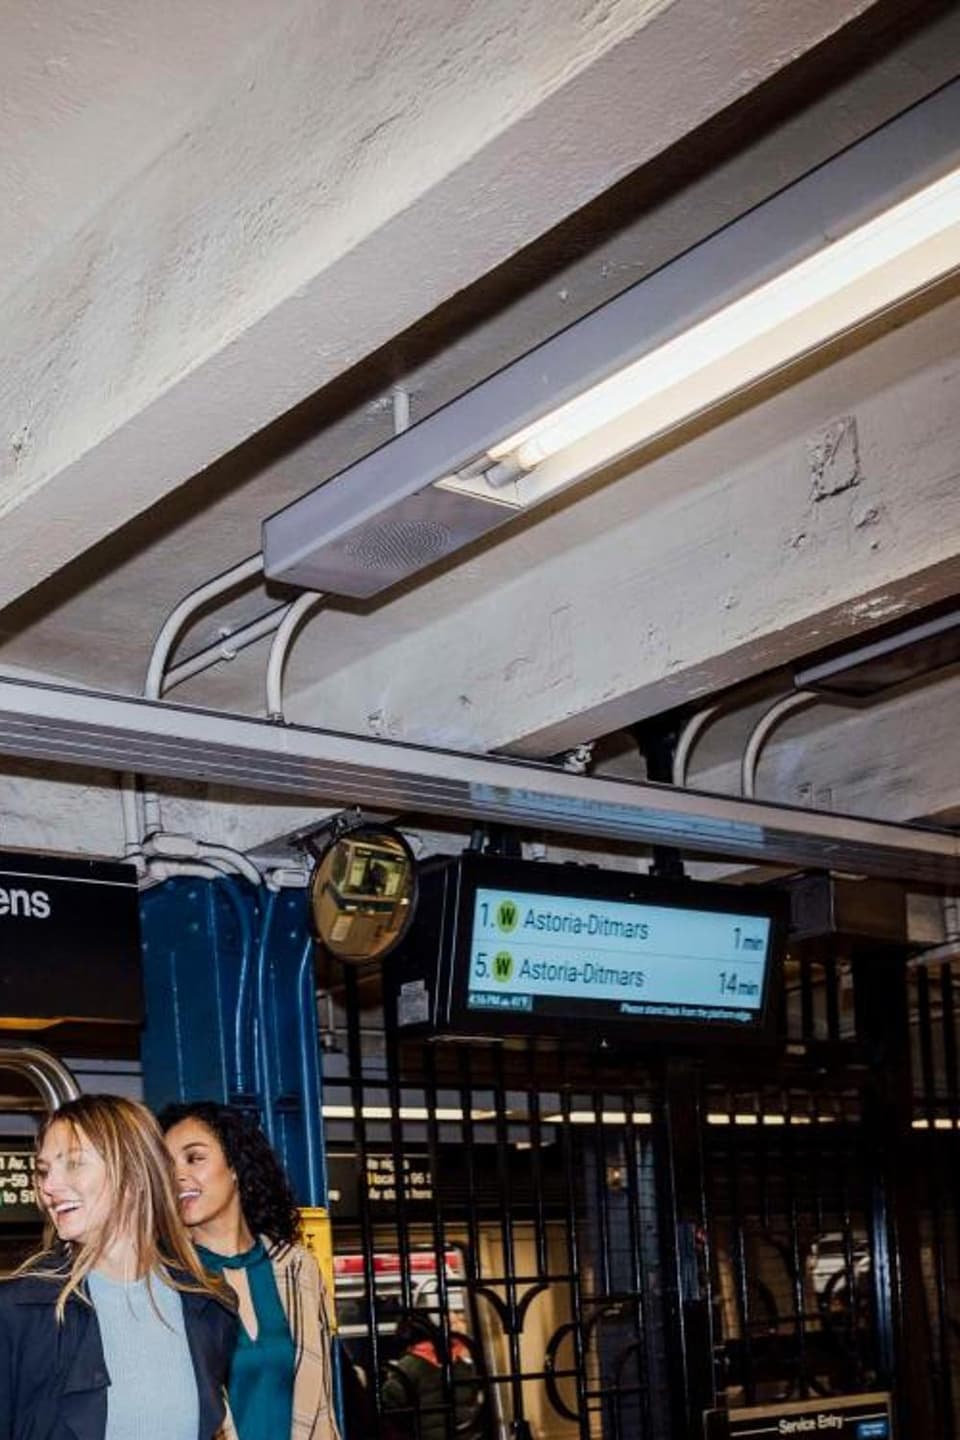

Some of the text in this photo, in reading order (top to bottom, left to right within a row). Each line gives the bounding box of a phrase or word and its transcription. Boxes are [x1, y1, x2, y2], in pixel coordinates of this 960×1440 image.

[500, 905, 516, 927] W
[524, 908, 649, 940] Astoria-Ditmars
[733, 927, 741, 950] 1
[743, 937, 763, 952] min
[495, 956, 512, 977] W
[519, 959, 645, 988] Astoria-Ditmars
[719, 972, 737, 996] 14
[738, 980, 759, 996] min
[3, 1190, 17, 1204] to
[778, 1414, 843, 1435] Service Entry
